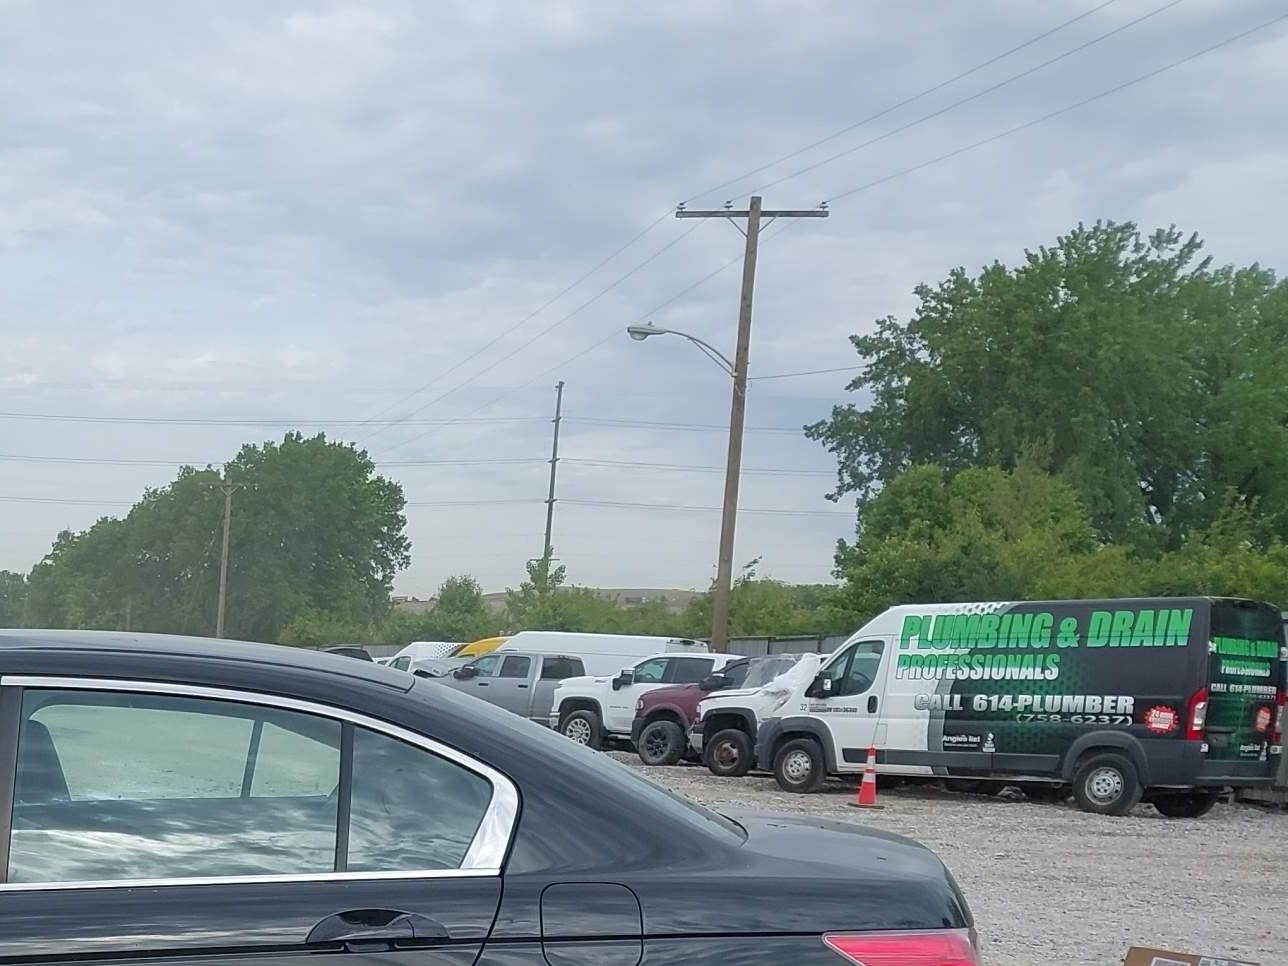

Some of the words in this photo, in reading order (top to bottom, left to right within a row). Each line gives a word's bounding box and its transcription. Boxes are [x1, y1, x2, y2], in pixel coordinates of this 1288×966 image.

[900, 612, 1054, 650] PLUMBING
[1057, 616, 1080, 648] &
[1087, 608, 1193, 647] DRAIN
[896, 653, 1060, 681] PROFESSIONALS
[914, 694, 963, 711] CALL
[972, 694, 1135, 714] 614-PLUMBER
[1016, 713, 1133, 726] (758-6237)
